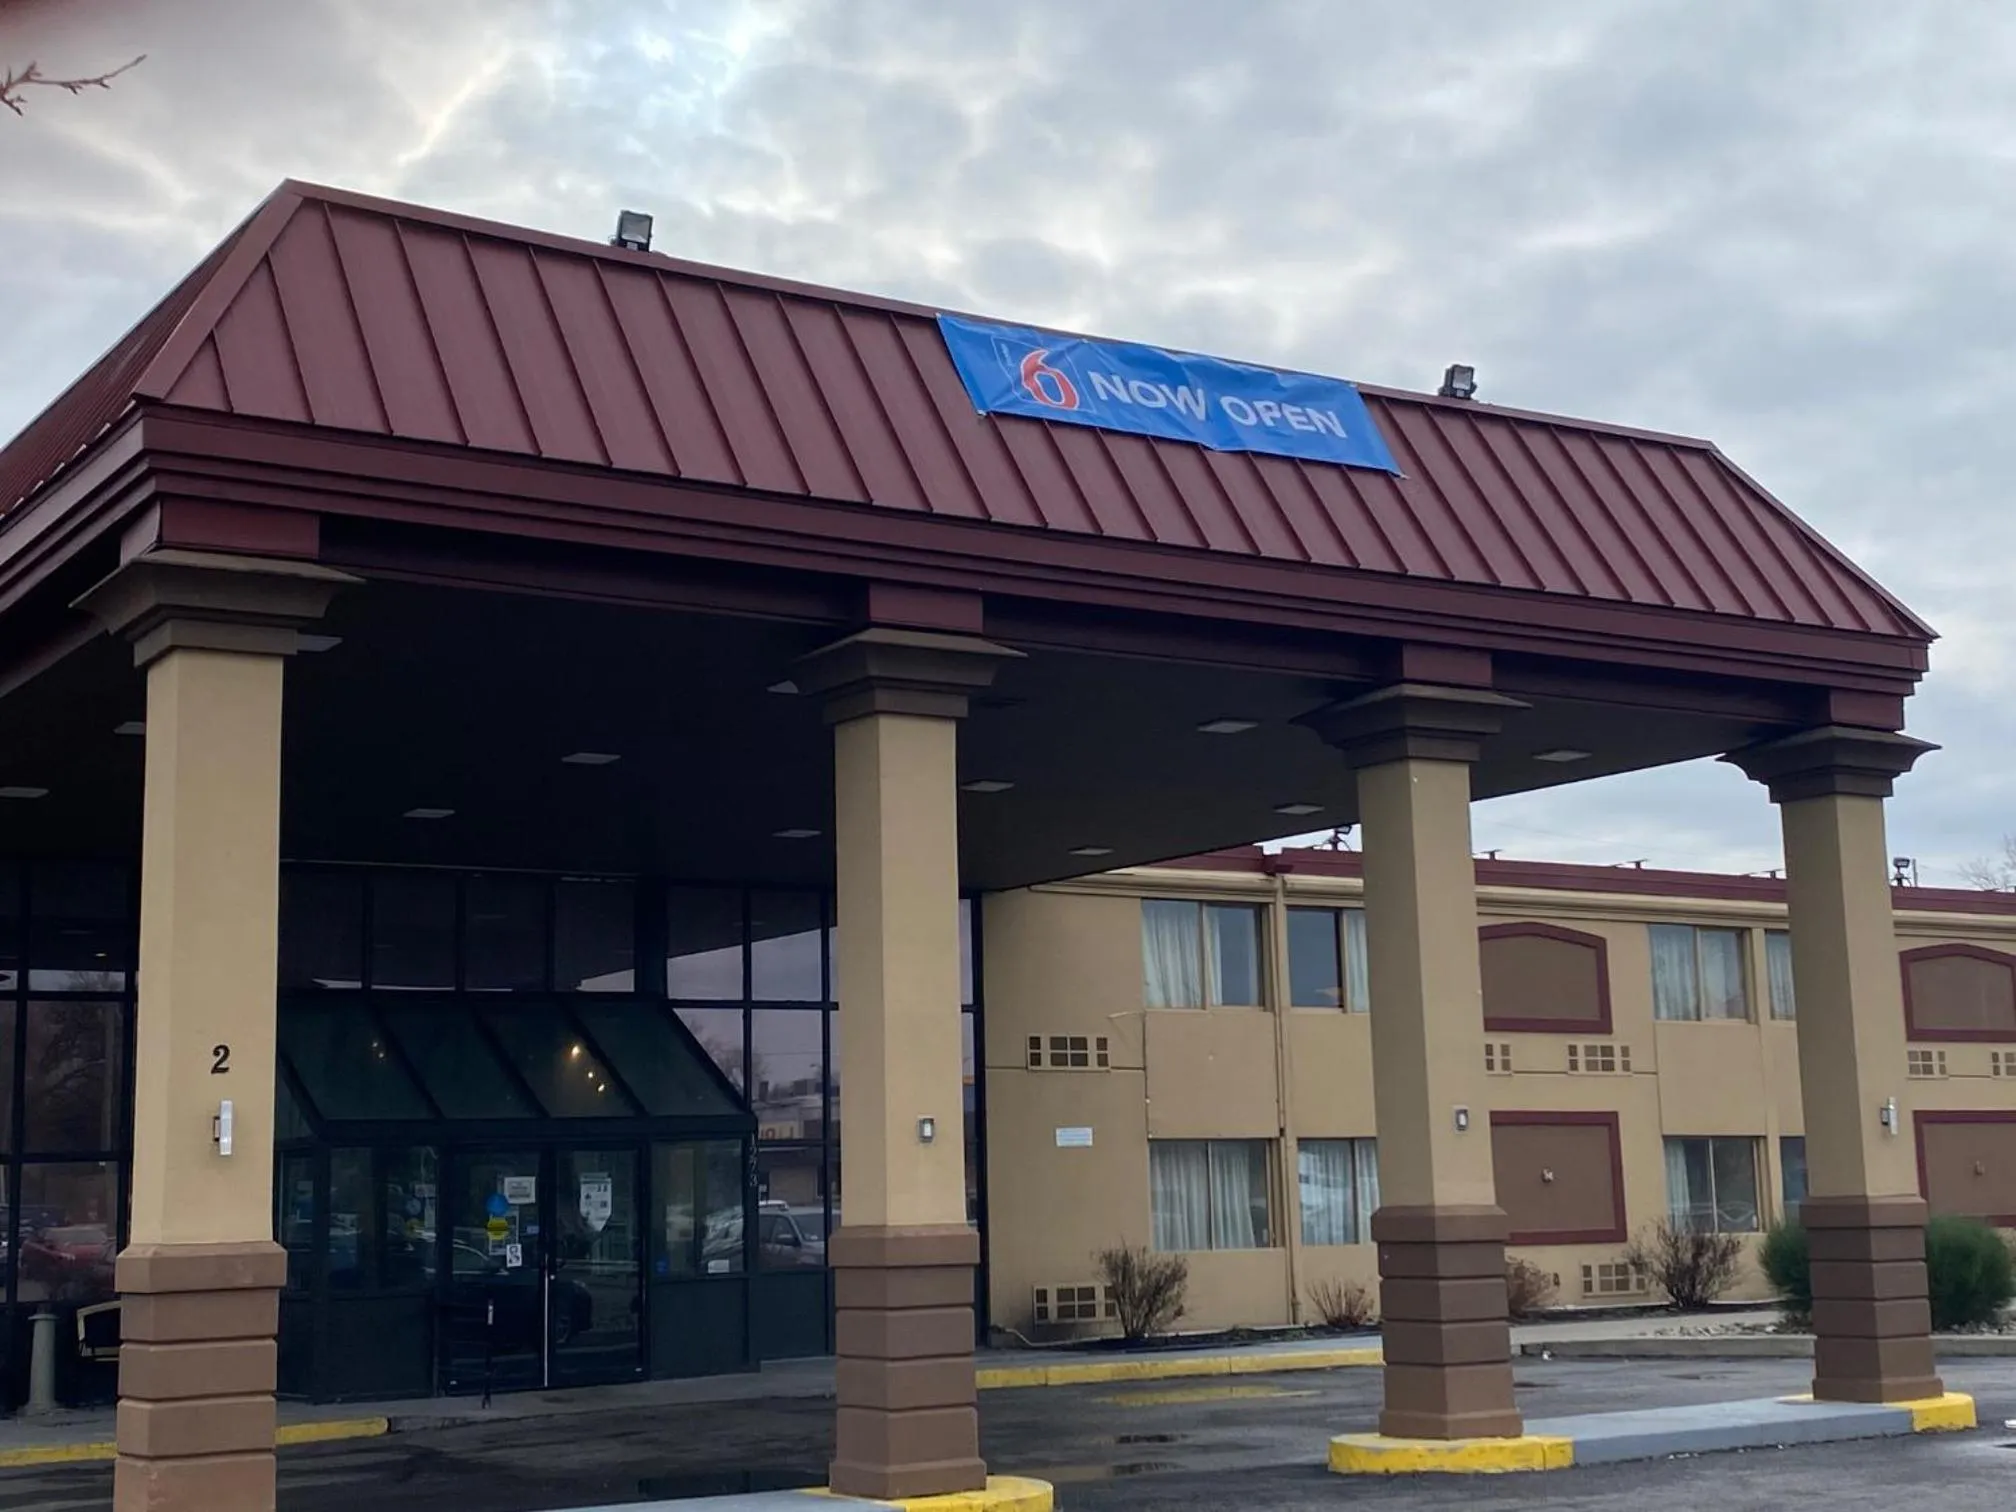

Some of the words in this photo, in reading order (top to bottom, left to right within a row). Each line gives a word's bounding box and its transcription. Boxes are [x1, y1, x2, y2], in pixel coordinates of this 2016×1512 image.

[1020, 349, 1079, 410] 6
[1088, 371, 1206, 421] NOW
[1220, 396, 1348, 438] OPEN
[210, 1044, 230, 1074] 2
